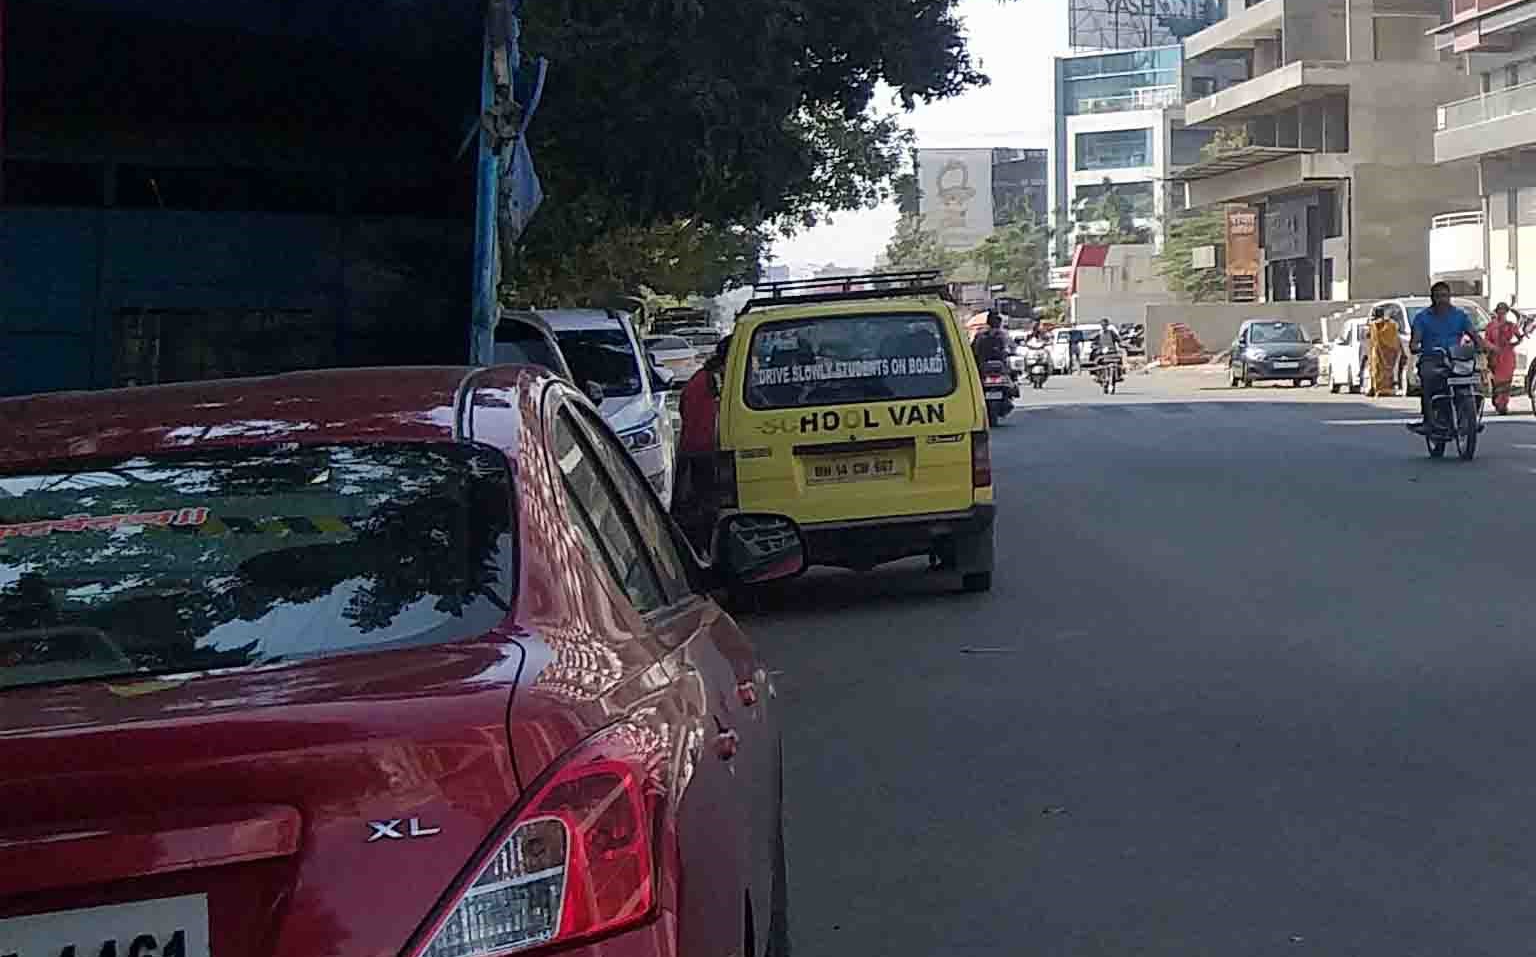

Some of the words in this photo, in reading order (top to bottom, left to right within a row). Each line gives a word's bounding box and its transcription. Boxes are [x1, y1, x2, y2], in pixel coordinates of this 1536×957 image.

[758, 368, 791, 385] DRIVE
[891, 357, 906, 375] ON
[888, 403, 945, 426] VAN
[366, 818, 440, 842] XL
